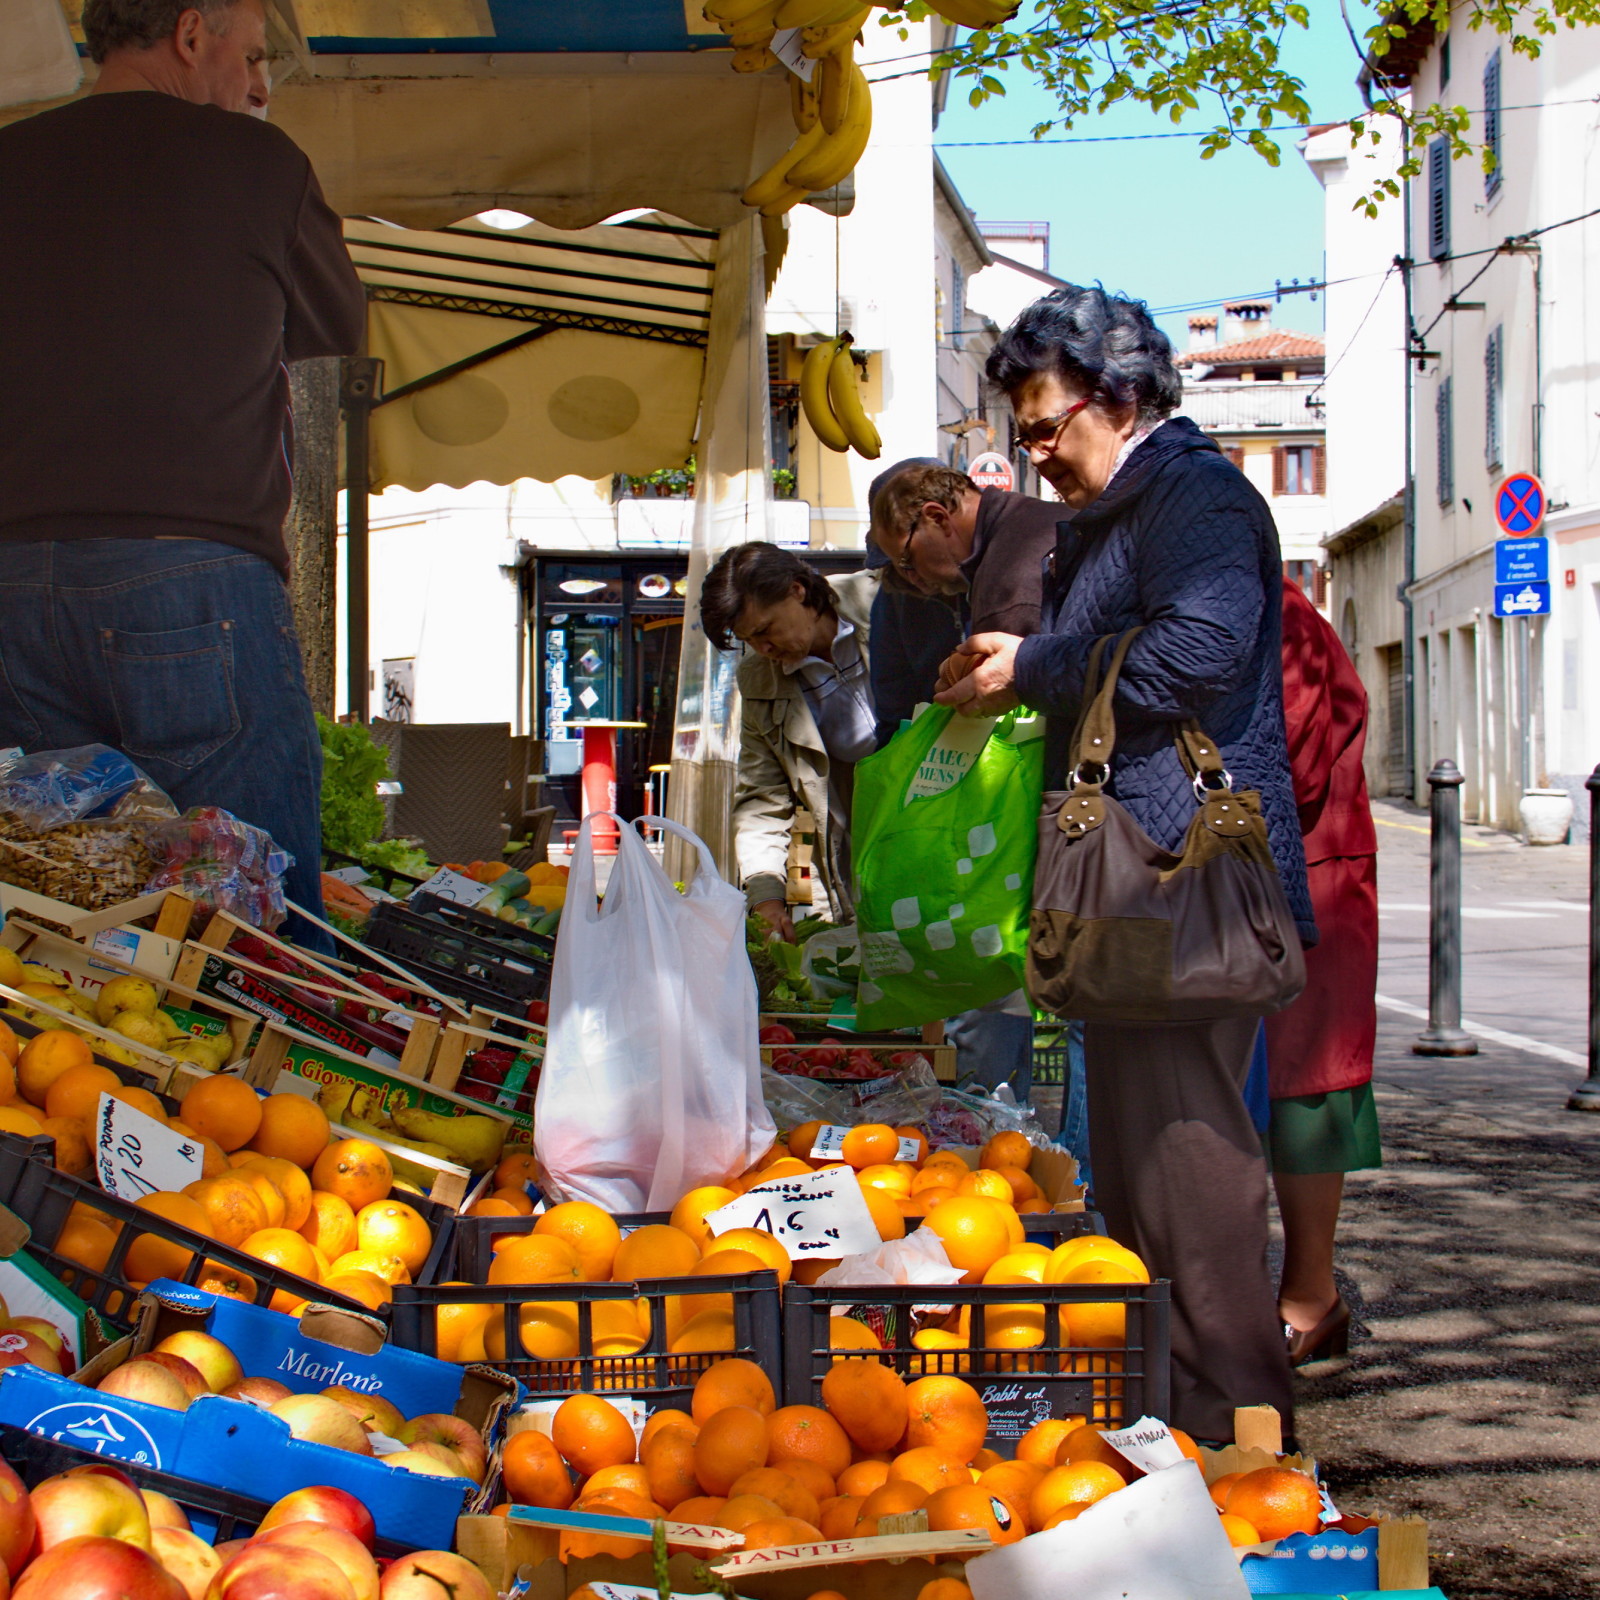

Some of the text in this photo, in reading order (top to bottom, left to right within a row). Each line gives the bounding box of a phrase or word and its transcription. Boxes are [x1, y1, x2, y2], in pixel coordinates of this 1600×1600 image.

[972, 475, 1010, 486] UNION
[240, 993, 285, 1025] FRAGOLE
[241, 974, 368, 1057] Torrevecchia
[277, 1347, 384, 1392] Marlene
[981, 1383, 1023, 1404] Babbi
